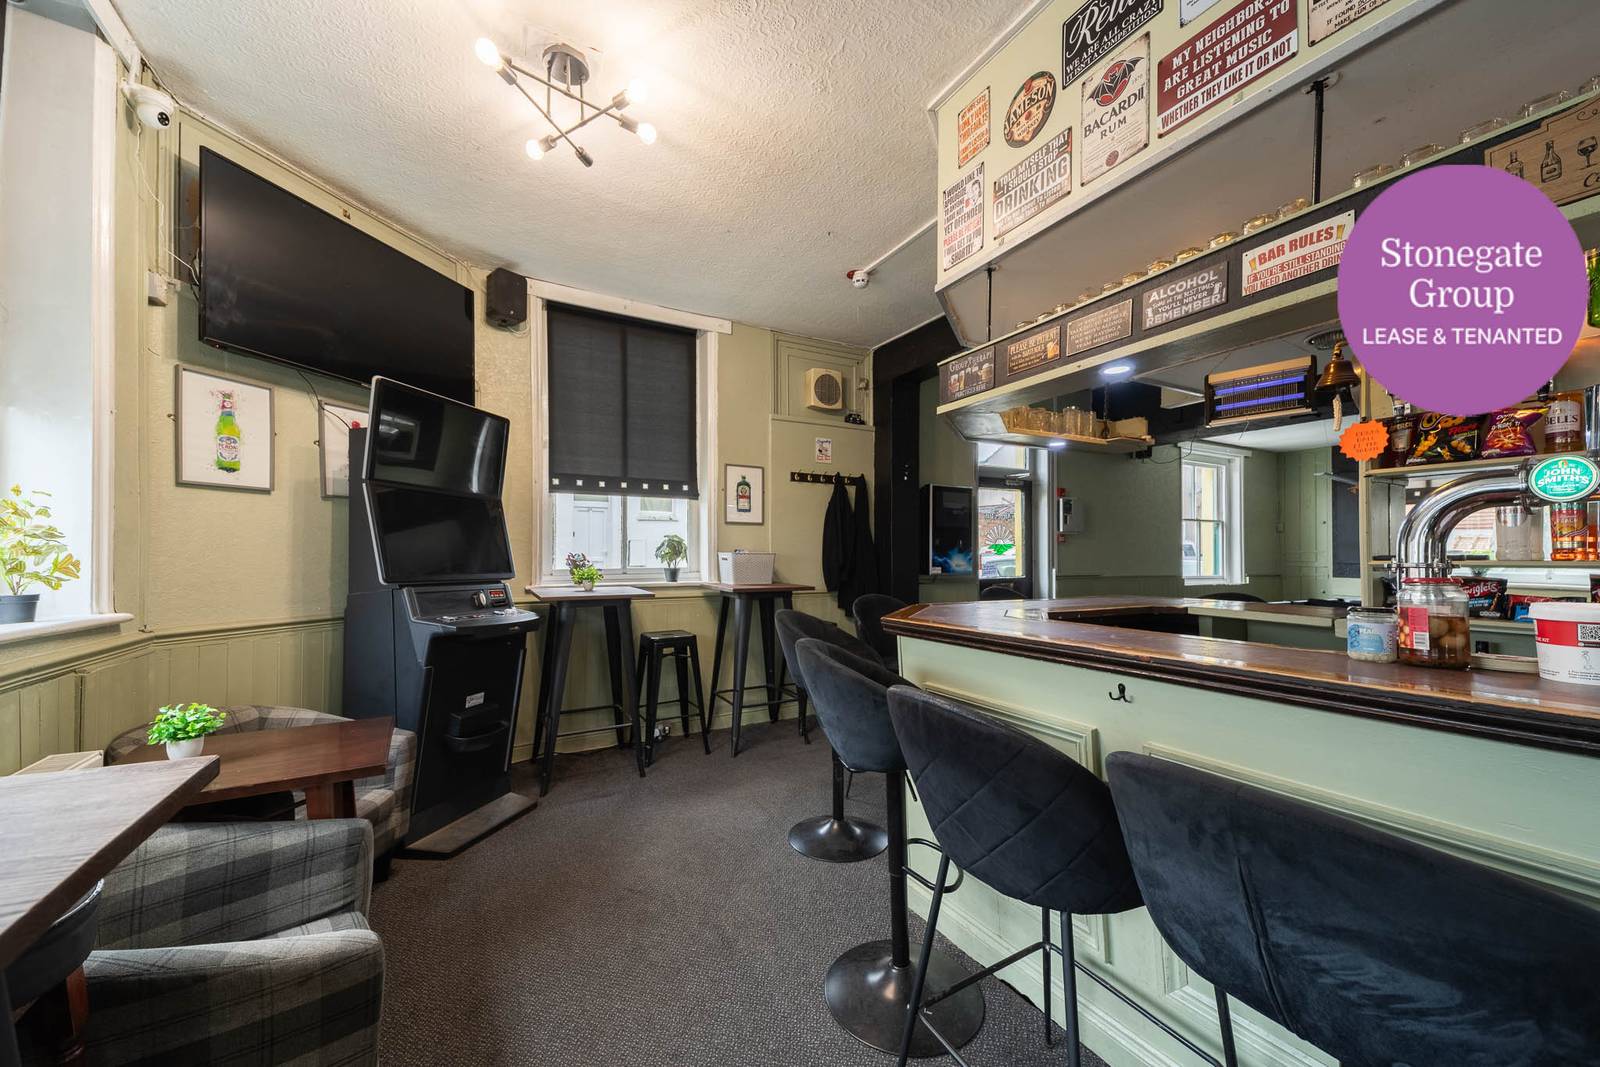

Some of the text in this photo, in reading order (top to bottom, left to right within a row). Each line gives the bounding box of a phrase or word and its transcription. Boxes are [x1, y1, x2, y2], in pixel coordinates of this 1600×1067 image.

[1334, 4, 1356, 20] FOUND
[1066, 71, 1074, 83] IT
[1099, 3, 1158, 54] COMPETITION
[1066, 57, 1080, 74] WE
[1081, 40, 1100, 62] ARE
[1100, 25, 1121, 47] ALL
[1163, 68, 1189, 92] ARE
[1192, 15, 1266, 73] LISTENING
[1269, 0, 1290, 21] TO
[1172, 46, 1192, 70] MY
[1176, 28, 1273, 99] GREAT MUSIC
[1161, 36, 1293, 130] WHETHER THEY LIKE IT OR NOT
[1004, 80, 1055, 136] JAMESON
[1101, 115, 1127, 140] RUM
[1000, 171, 1018, 187] TOLD
[1019, 146, 1048, 173] MYSELF
[1049, 130, 1069, 152] THAT
[1009, 166, 1038, 190] SHOULD
[1039, 150, 1059, 169] STOP
[995, 156, 1069, 219] DRINKING
[1247, 241, 1346, 285] IF YOU'RE STILL STANDING
[1257, 226, 1334, 266] BAR RULES
[1149, 270, 1218, 303] ALCOHOL
[1244, 253, 1342, 295] YOU NEED ANOTHER DRIN
[1146, 287, 1226, 328] REMEMBER!
[1158, 291, 1208, 313] YOU'LL NEVER
[1544, 467, 1581, 477] JOHN
